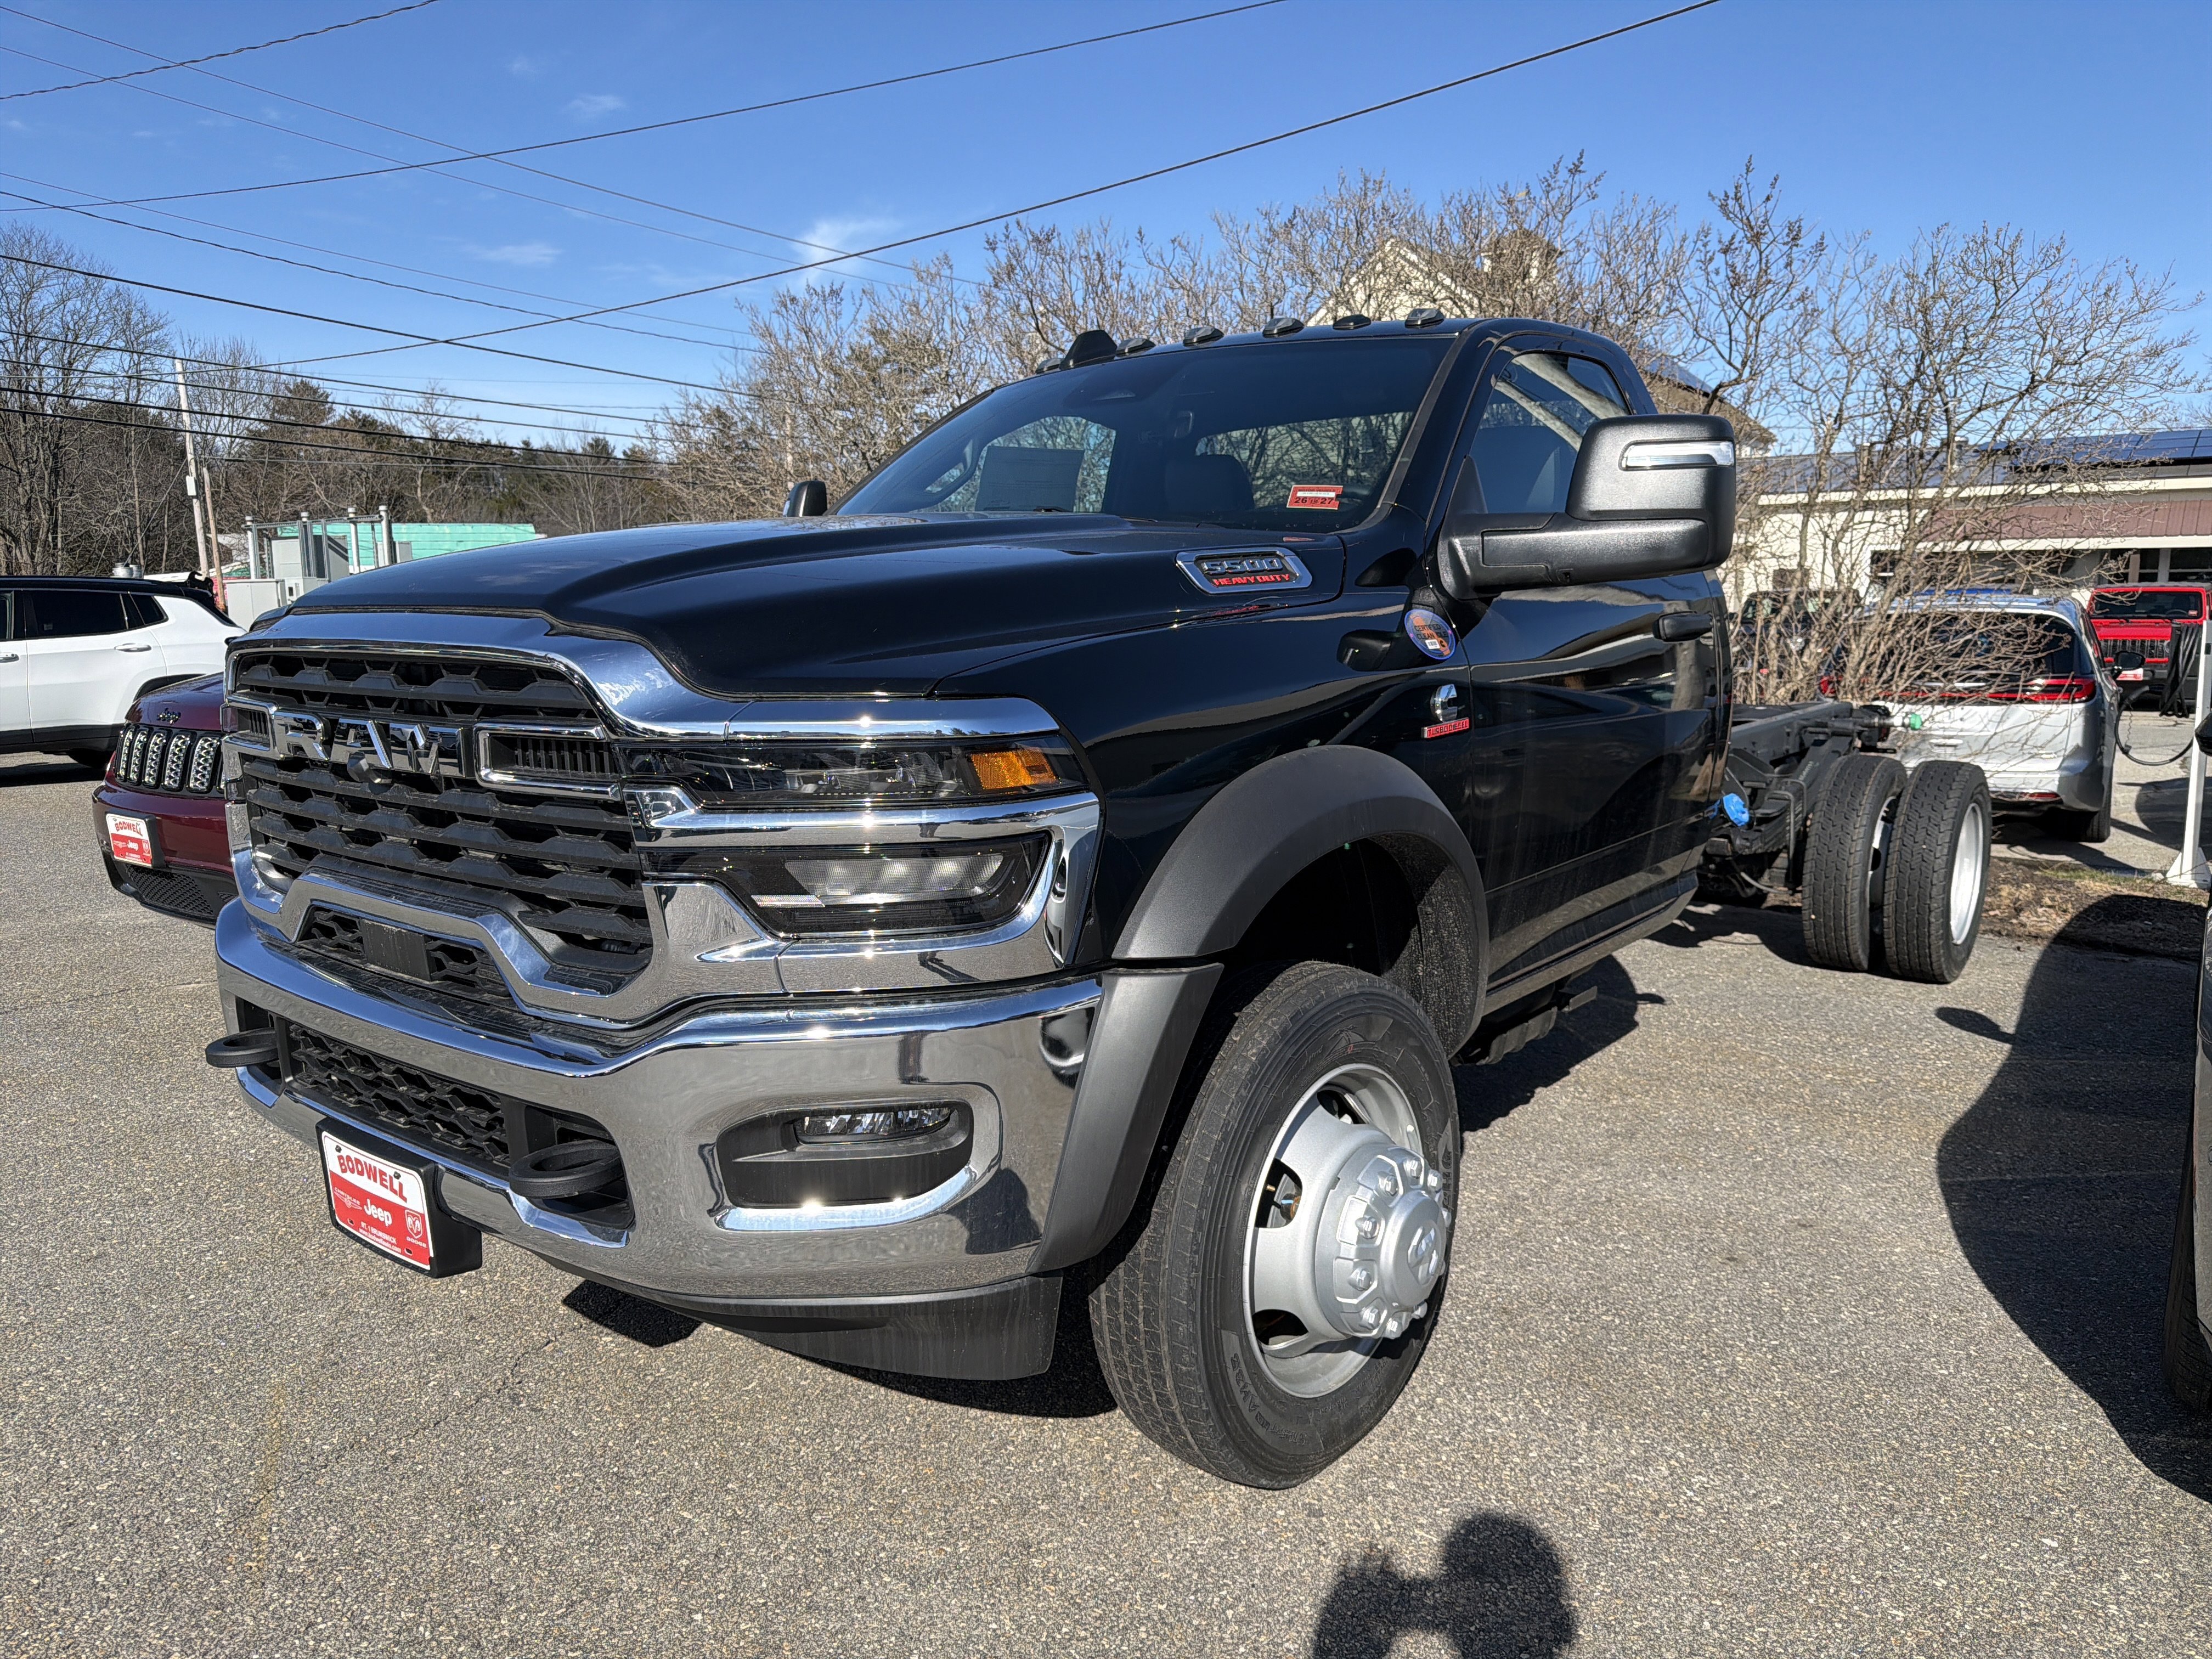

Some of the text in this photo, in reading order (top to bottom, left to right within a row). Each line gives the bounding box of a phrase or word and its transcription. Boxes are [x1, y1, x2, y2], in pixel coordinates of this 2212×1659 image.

[1202, 558, 1283, 575] 5500
[1212, 573, 1289, 586] HEAVY DUTY
[1427, 720, 1468, 736] TURBO DIESEL
[274, 713, 467, 779] RAM
[115, 821, 143, 837] BODWELL
[337, 1154, 408, 1203] BODWELL
[334, 1187, 360, 1205] CHRYSLER
[363, 1198, 392, 1227] Jeep
[371, 1227, 397, 1245] BRUNSWICK
[407, 1236, 427, 1248] DODGE
